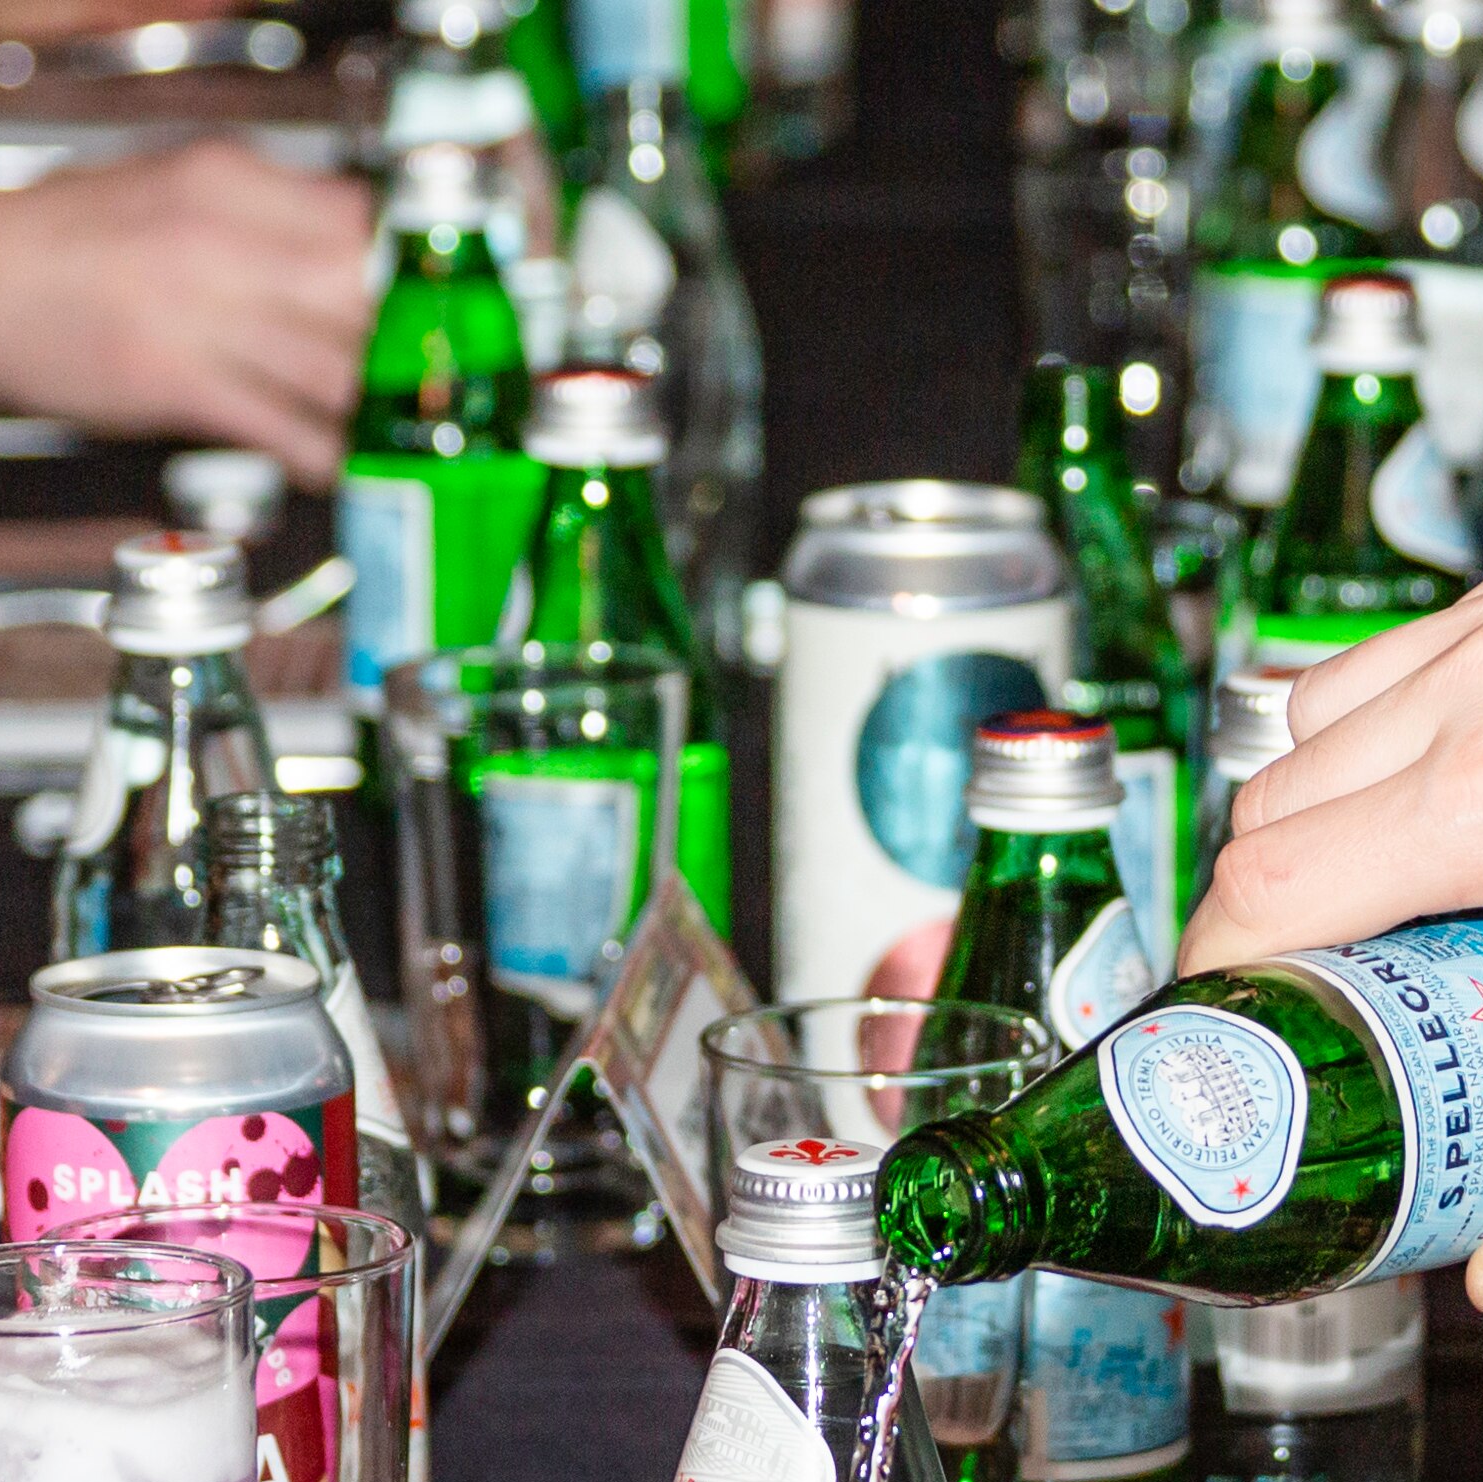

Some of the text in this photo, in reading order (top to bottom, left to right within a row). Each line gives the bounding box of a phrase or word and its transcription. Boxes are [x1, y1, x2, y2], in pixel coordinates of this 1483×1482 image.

[1166, 1034, 1222, 1048] ITALIA
[1340, 946, 1474, 1210] S.PELLEGRIN
[1443, 1008, 1482, 1087] NATURAL
[1137, 1058, 1270, 1164] SAN PELLEGRINO TERME
[52, 1163, 242, 1207] SPLASH
